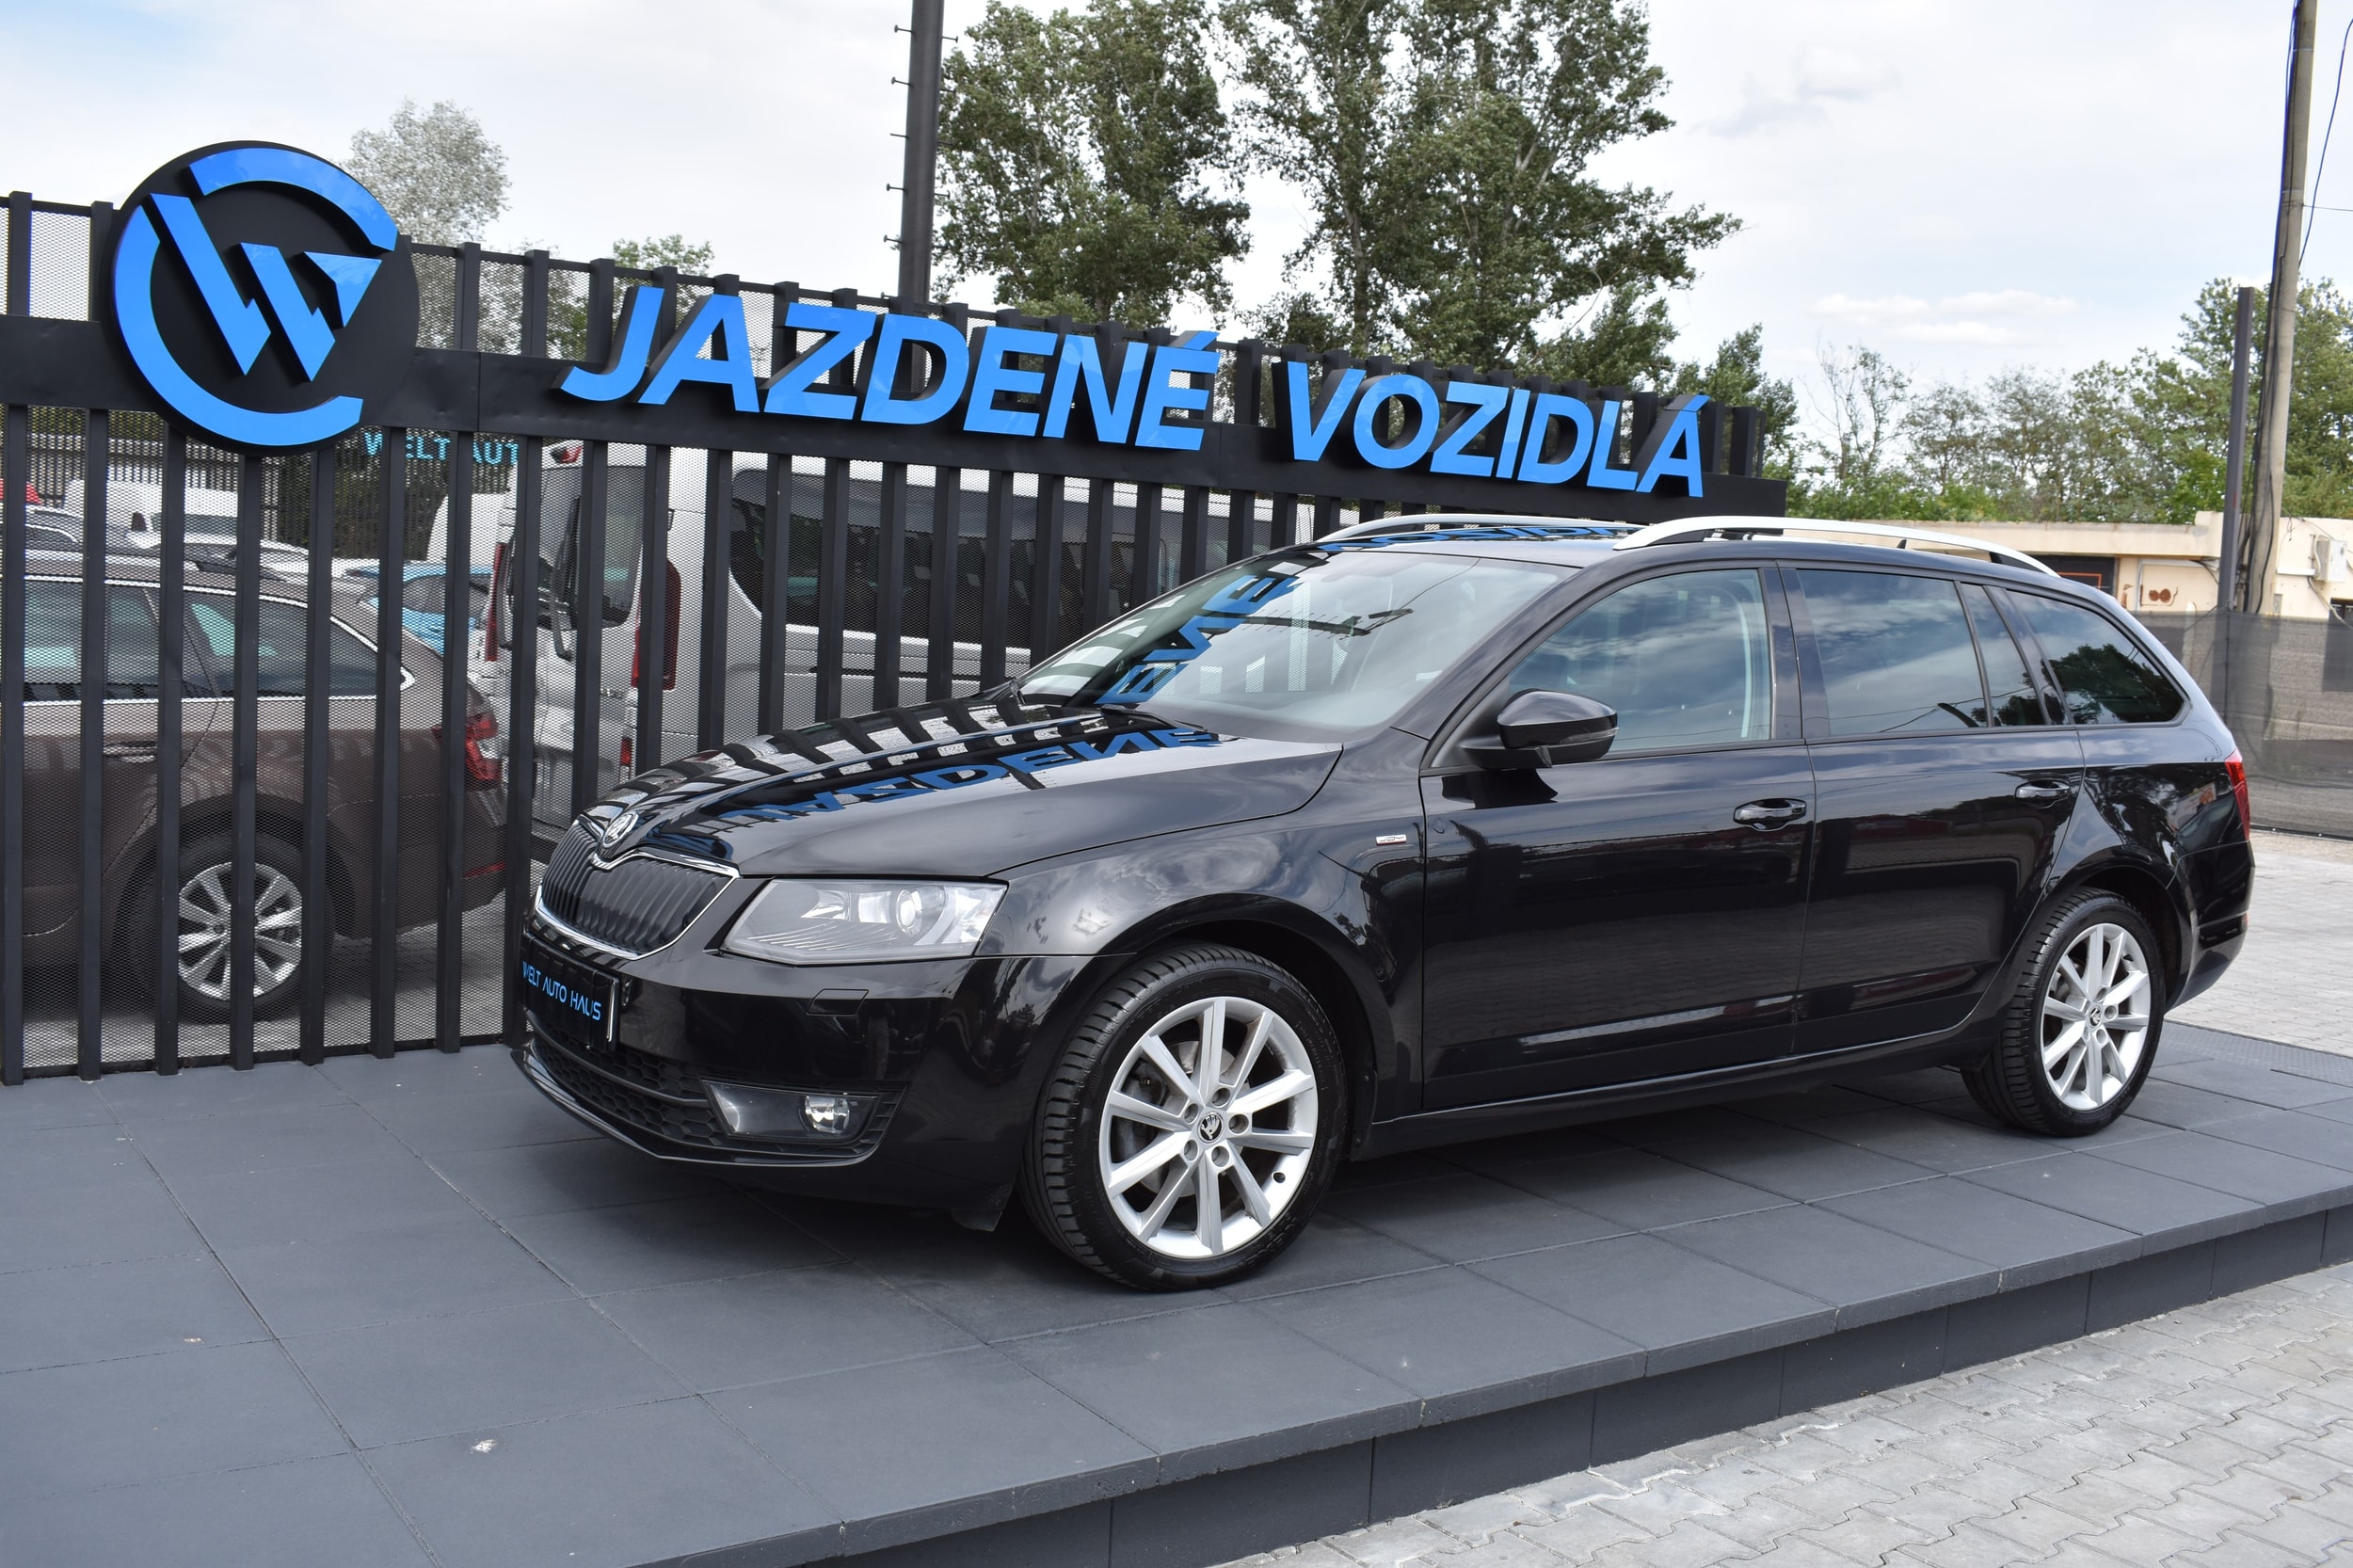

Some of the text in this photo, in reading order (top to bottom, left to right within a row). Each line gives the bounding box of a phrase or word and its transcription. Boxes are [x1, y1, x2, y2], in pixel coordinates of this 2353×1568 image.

[560, 286, 1711, 499] JAZDENÉ VOZIDLÁ
[522, 960, 601, 1021] WELT AUTO HAUS
